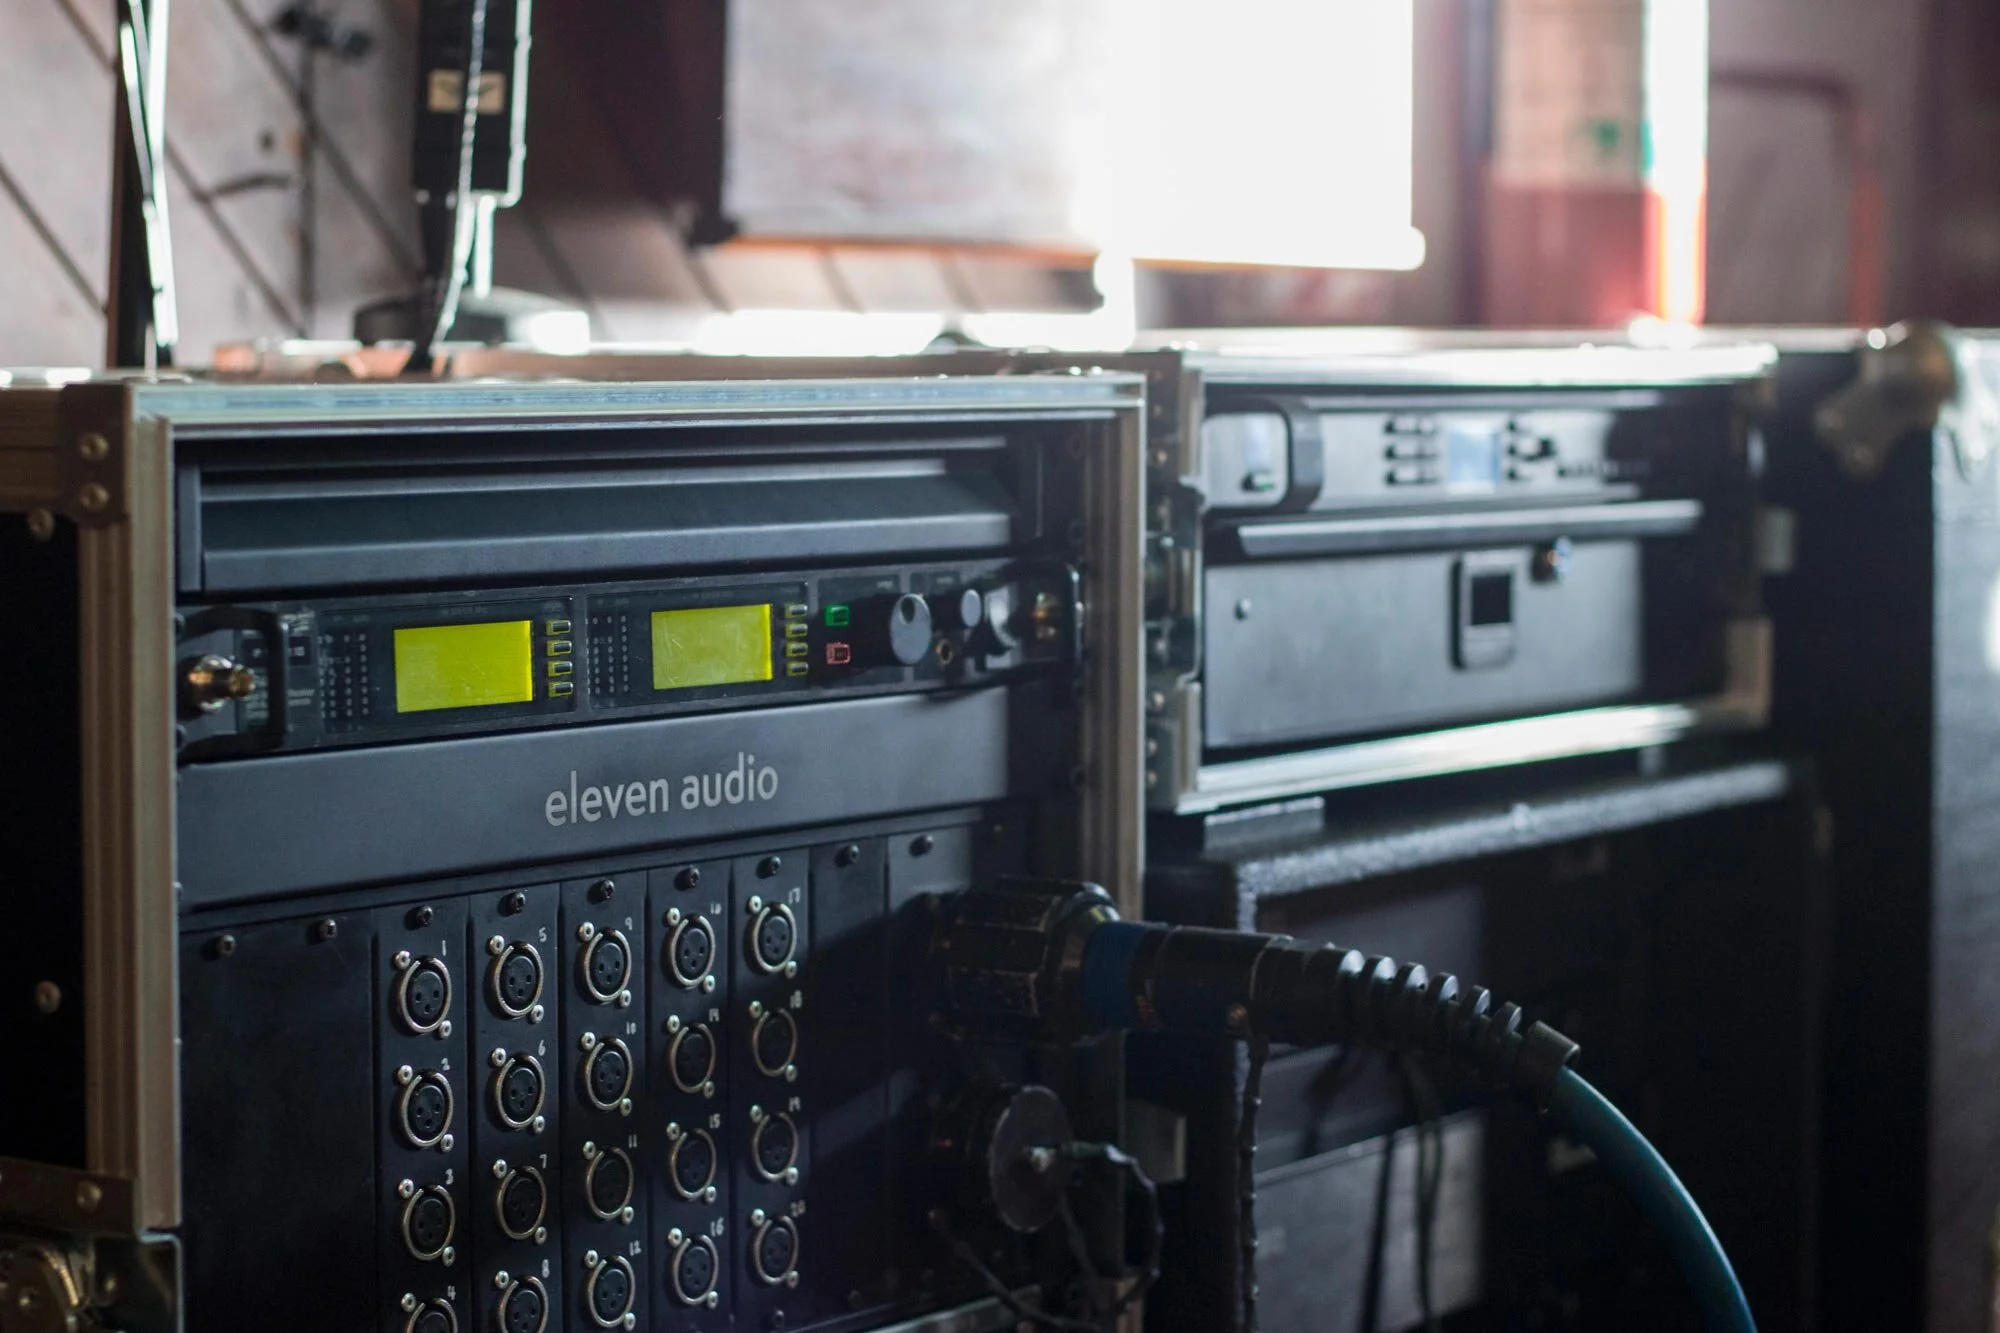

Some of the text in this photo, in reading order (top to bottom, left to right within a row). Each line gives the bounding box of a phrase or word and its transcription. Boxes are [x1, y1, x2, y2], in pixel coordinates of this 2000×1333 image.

[545, 752, 779, 826] eleven audio
[625, 916, 632, 931] 9
[538, 927, 547, 942] 5
[442, 940, 447, 956] 1
[537, 1040, 546, 1056] 6
[442, 1057, 450, 1071] 2
[709, 1113, 721, 1128] 15
[628, 1134, 638, 1148] 11
[539, 1154, 548, 1169] 7
[445, 1168, 453, 1185] 3
[710, 1217, 724, 1236] 16
[447, 1285, 456, 1300] 4
